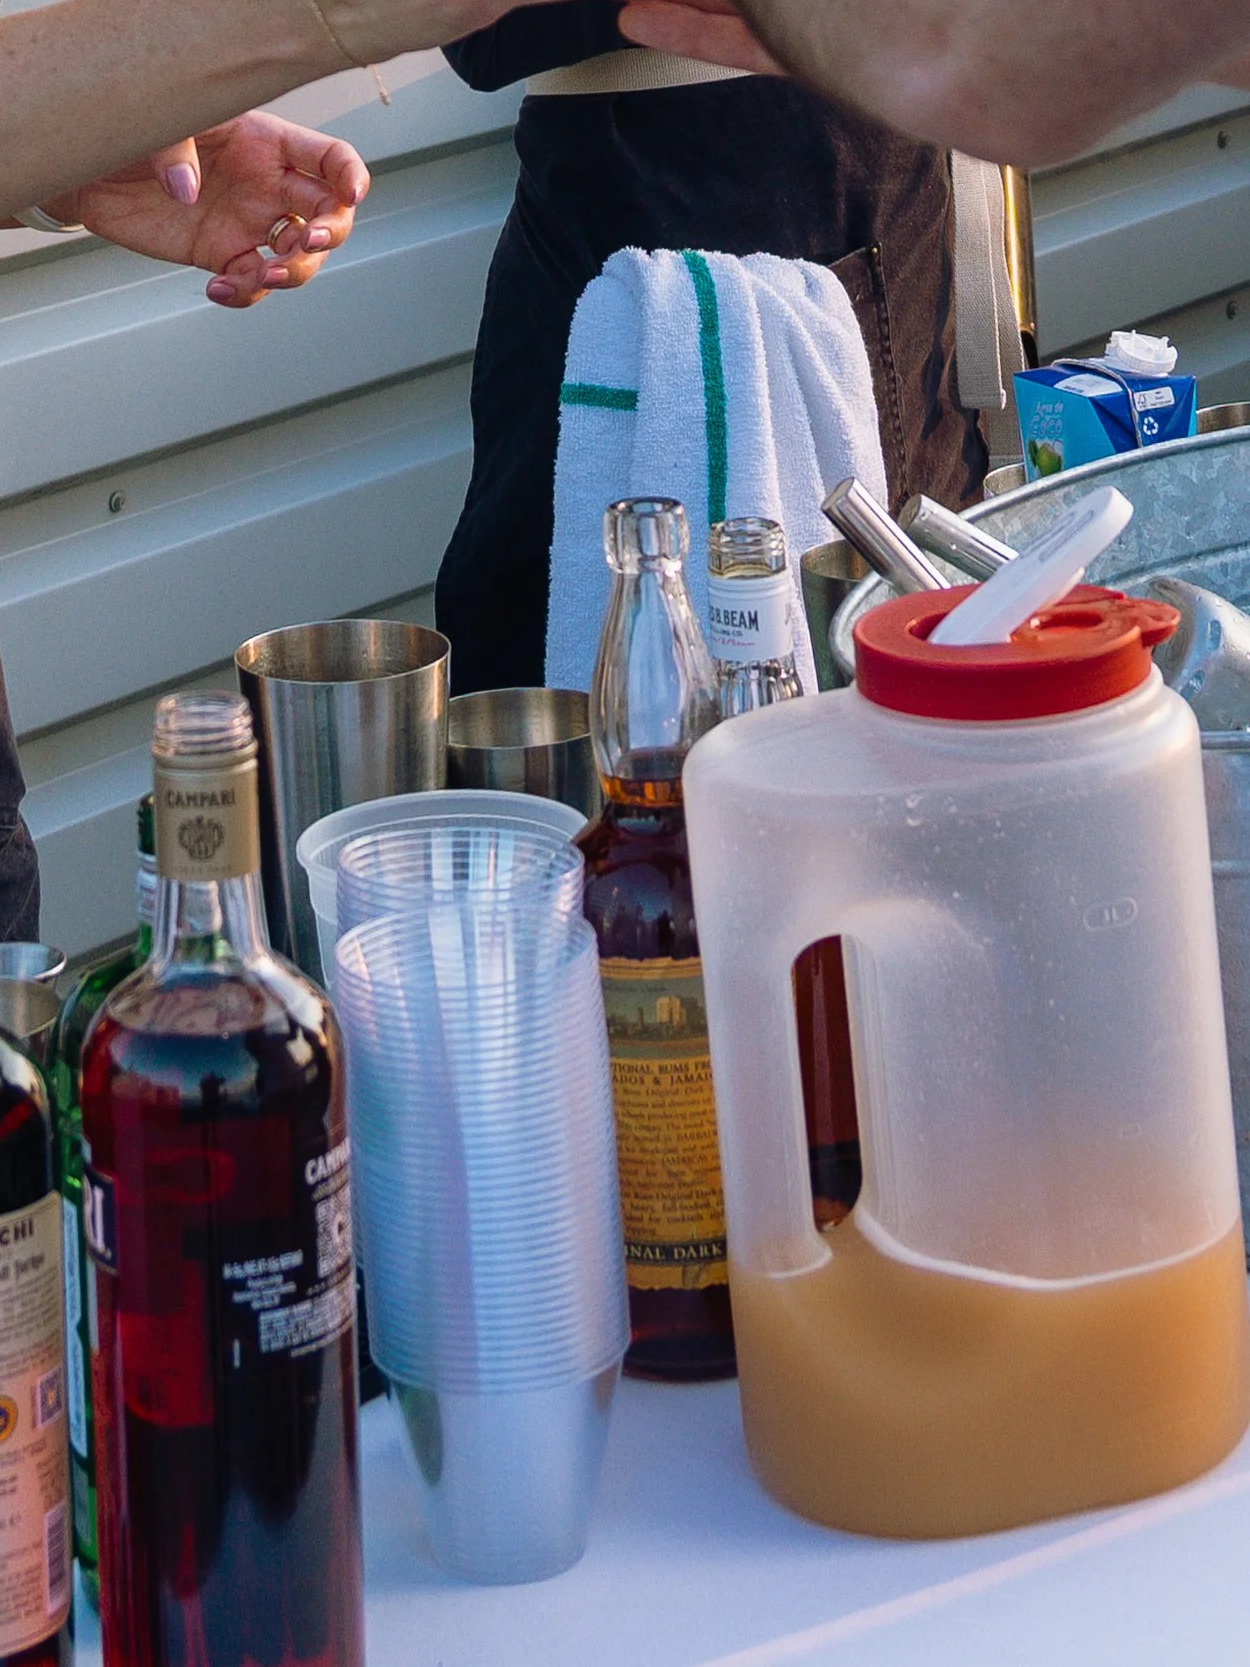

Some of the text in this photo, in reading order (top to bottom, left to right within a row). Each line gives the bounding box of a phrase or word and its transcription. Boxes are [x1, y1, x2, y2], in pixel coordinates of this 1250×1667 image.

[723, 609, 759, 632] BEAM
[166, 787, 236, 808] CAMPARI
[658, 1064, 690, 1075] RUMS
[652, 1075, 661, 1086] &
[673, 1242, 723, 1260] DARK
